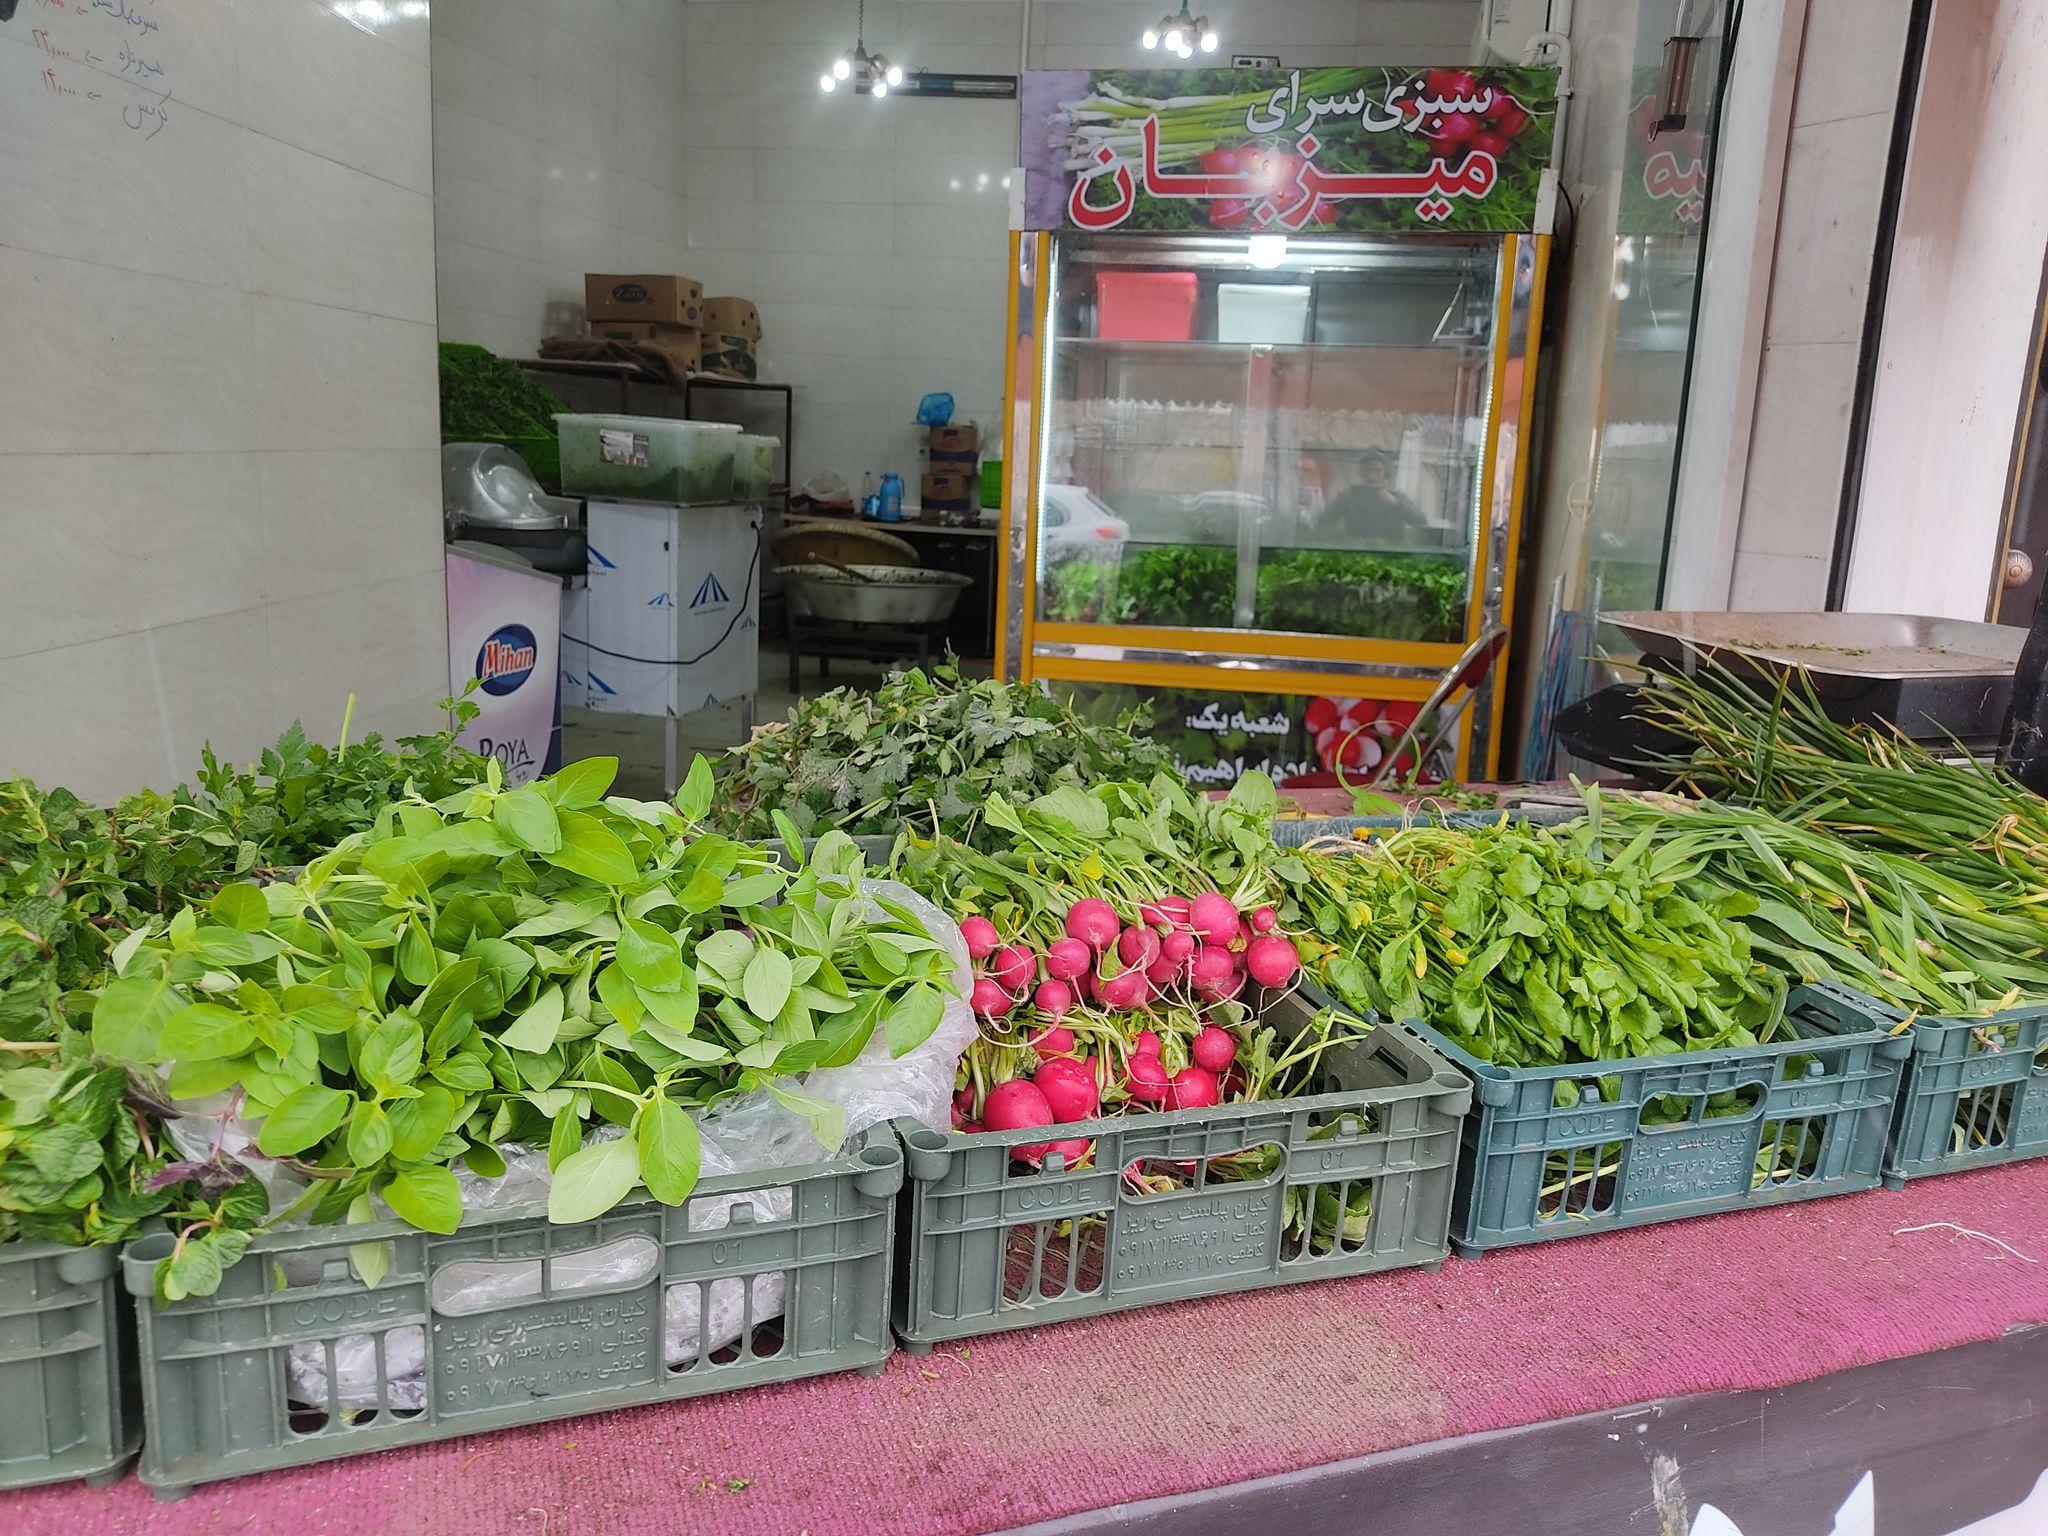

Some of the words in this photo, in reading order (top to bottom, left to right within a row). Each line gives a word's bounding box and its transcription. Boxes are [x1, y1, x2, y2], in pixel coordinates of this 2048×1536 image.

[1245, 70, 1366, 135] سرای
[1361, 80, 1493, 135] سبزی
[1068, 113, 1499, 231] میزبان
[482, 639, 534, 678] Mihan
[1230, 710, 1290, 738] شعبه
[1558, 1113, 1616, 1137] CODE
[1320, 1149, 1345, 1170] 01
[1018, 1181, 1092, 1210] CODE
[1233, 1193, 1270, 1220] کیان
[1178, 1199, 1229, 1222] پلاست
[1231, 1219, 1268, 1242] کمالی
[713, 1240, 744, 1265] 01
[1227, 1242, 1265, 1265] کاظمی
[294, 1291, 398, 1327] CODE
[599, 1296, 648, 1327] کیان
[601, 1326, 650, 1353] کمالی
[597, 1351, 647, 1379] کاظمی
